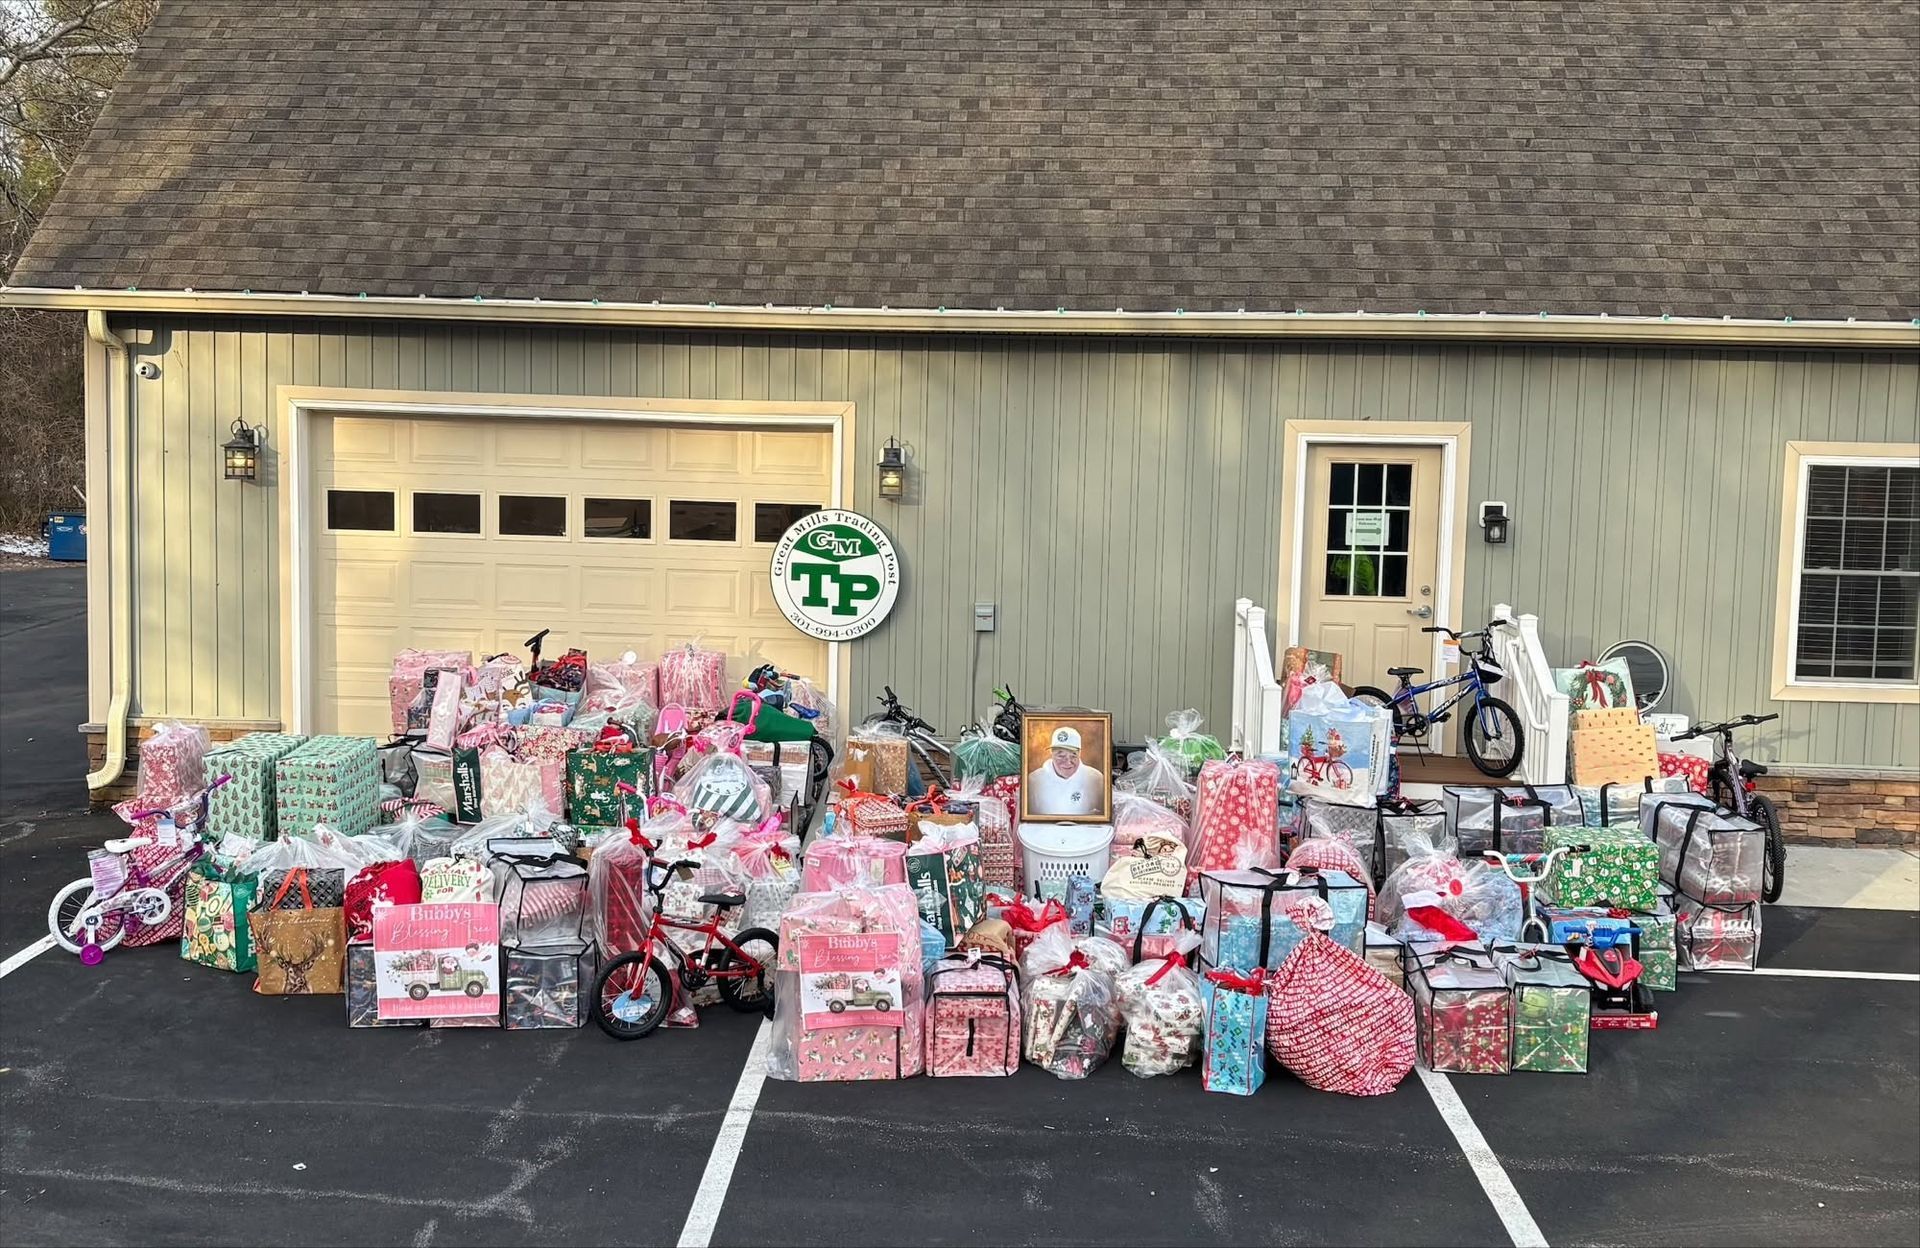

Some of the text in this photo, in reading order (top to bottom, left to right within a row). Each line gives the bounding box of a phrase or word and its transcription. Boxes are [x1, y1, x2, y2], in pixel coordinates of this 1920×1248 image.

[774, 512, 897, 585] Great Mills Trading Post
[808, 530, 861, 556] GM
[791, 562, 881, 616] TP
[790, 612, 876, 638] 301-994-0300
[457, 761, 475, 815] Marshalls
[437, 887, 454, 895] FOR
[391, 918, 492, 944] Blessing Tree
[814, 948, 861, 968] Blessing
